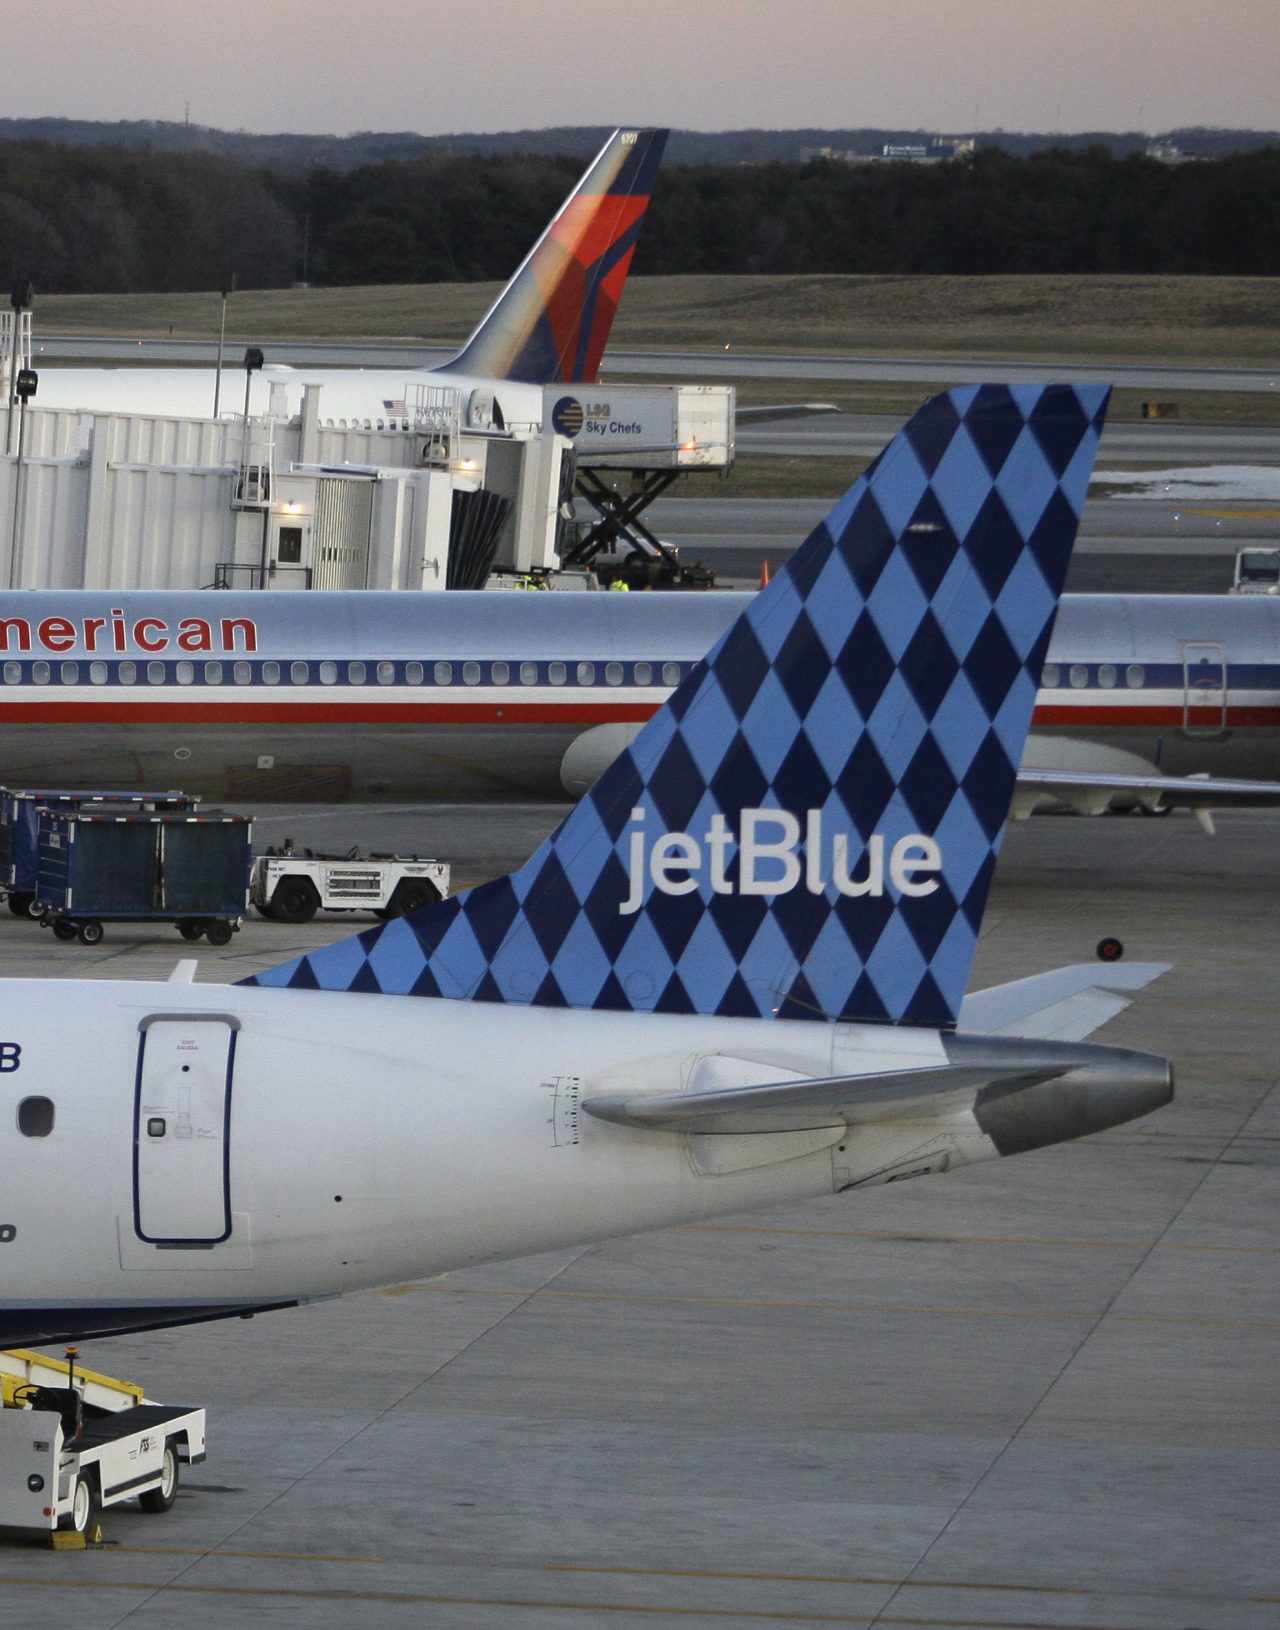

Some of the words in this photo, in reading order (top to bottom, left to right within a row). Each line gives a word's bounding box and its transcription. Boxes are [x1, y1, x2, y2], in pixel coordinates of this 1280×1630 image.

[586, 420, 607, 435] Sky
[610, 421, 642, 434] Chefs
[619, 807, 942, 915] jetBlue
